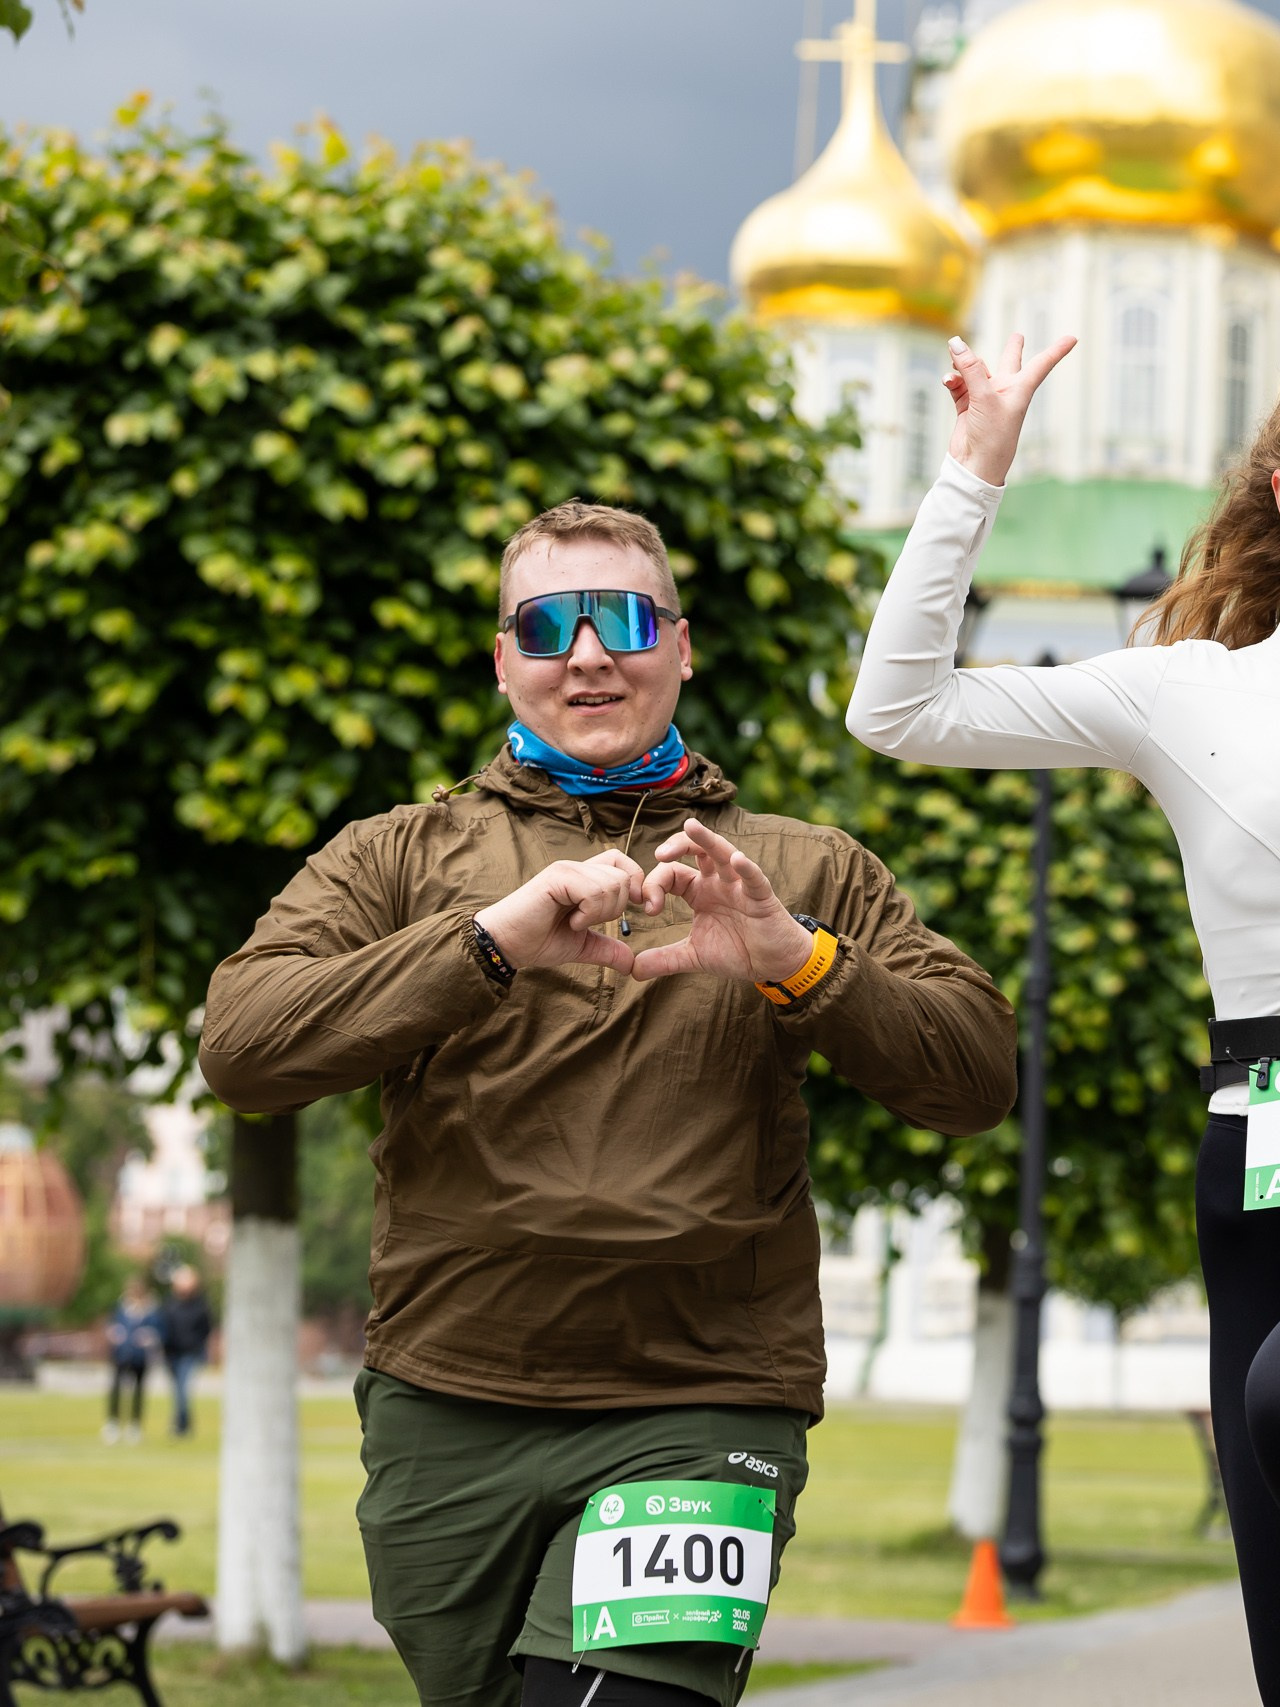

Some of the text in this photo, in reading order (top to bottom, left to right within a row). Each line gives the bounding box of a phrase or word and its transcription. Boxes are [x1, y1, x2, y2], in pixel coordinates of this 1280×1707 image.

[669, 1497, 712, 1515] Звук
[613, 1534, 744, 1587] 1400
[592, 1606, 617, 1640] A
[643, 1614, 664, 1623] Прайм
[732, 1608, 751, 1621] 30.05
